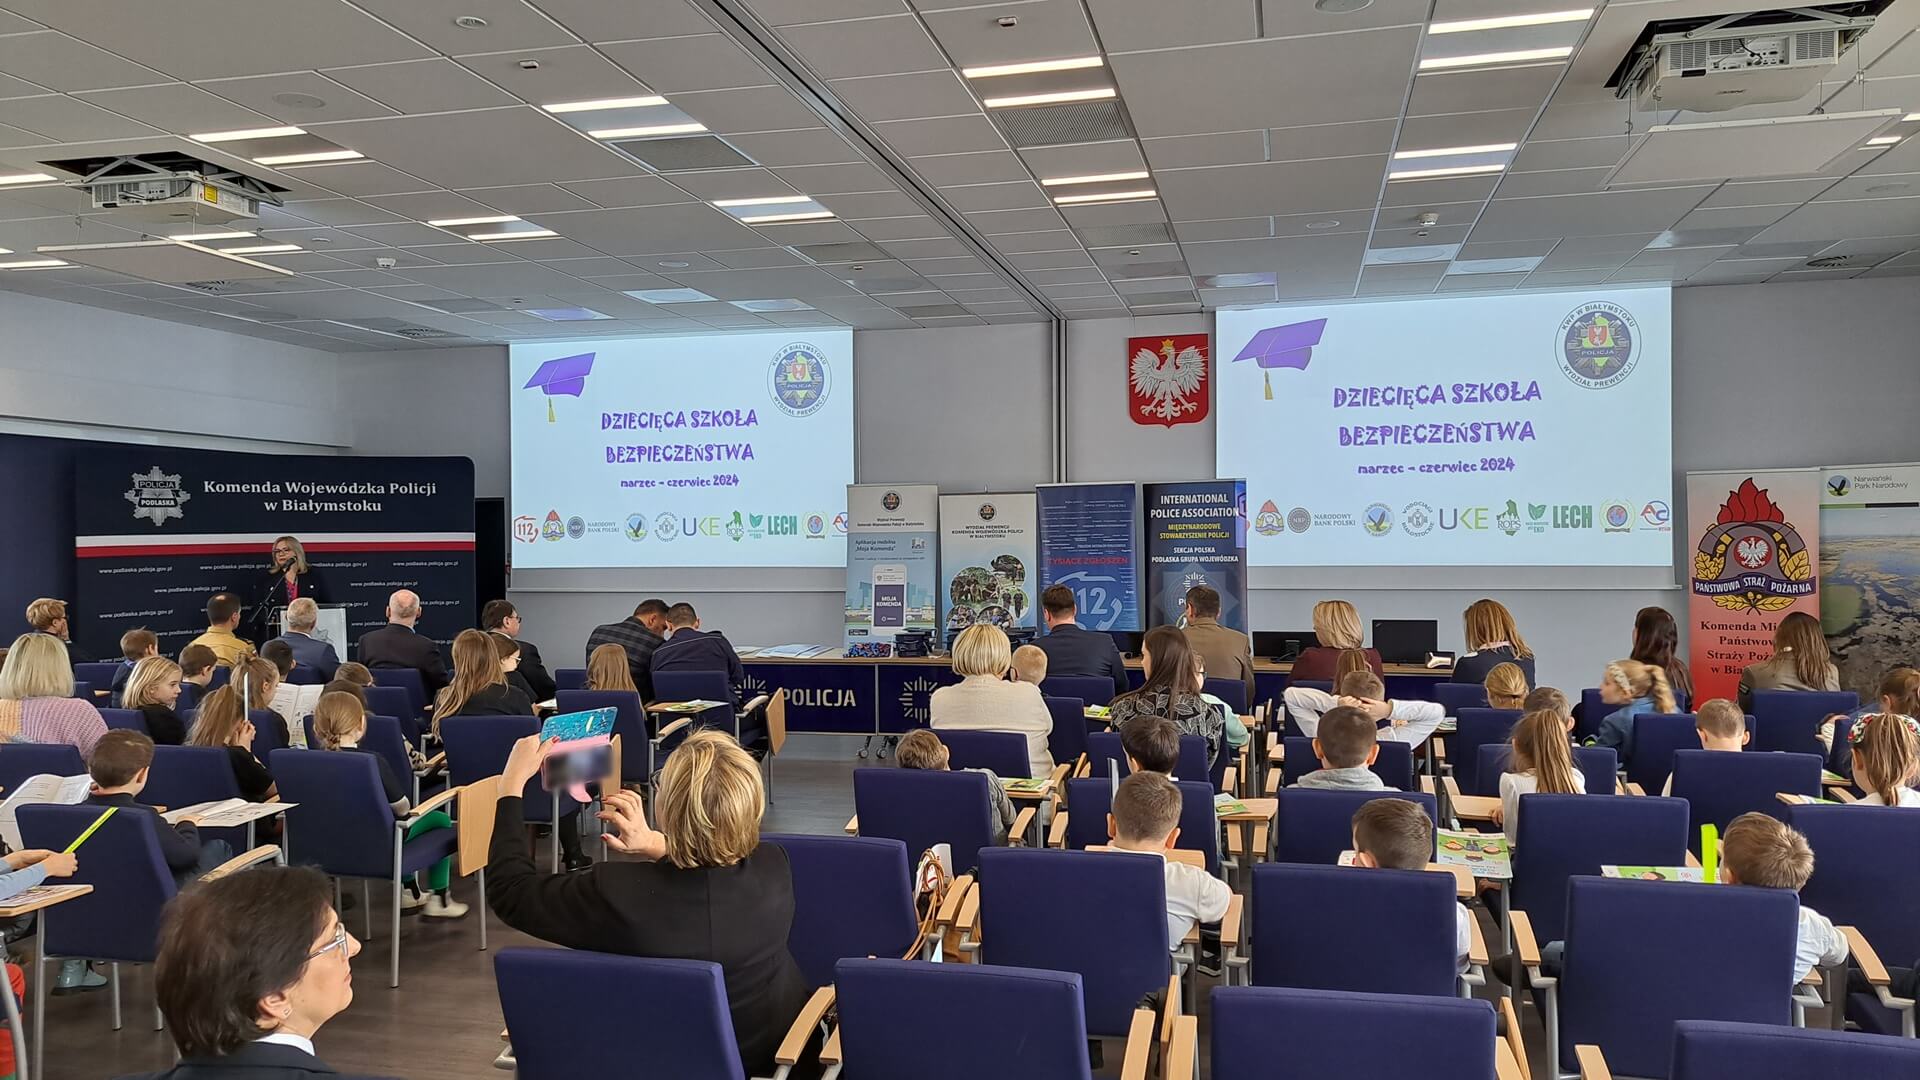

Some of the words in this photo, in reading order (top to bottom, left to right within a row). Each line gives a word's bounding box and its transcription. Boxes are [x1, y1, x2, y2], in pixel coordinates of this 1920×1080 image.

[1562, 314, 1575, 330] KWP
[1585, 304, 1635, 328] BIAŁYMSTOKU
[1563, 364, 1591, 387] WYDZIAŁ
[1594, 361, 1633, 387] PREWENCJI
[1333, 385, 1446, 410] DZIECIĘCA
[1451, 380, 1542, 405] SZKOŁA
[601, 411, 687, 432] DZIECIĘCA
[691, 409, 758, 428] SZKOŁA
[1338, 420, 1537, 446] BEZPIECZEŃSTWA
[605, 443, 754, 463] BEZPIECZEŃSTWA
[1358, 463, 1404, 474] marzec
[1419, 460, 1477, 473] czerwiec
[1480, 457, 1515, 473] 2024
[204, 481, 281, 493] Komenda
[285, 482, 385, 496] Wojewódzka
[390, 482, 437, 496] Policji
[620, 478, 656, 488] marzec
[667, 477, 711, 487] czerwiec
[712, 474, 739, 487] 2024
[264, 502, 278, 511] w
[282, 499, 382, 514] Białymstoku
[1161, 494, 1229, 504] INTERNATIONAL
[1151, 508, 1180, 518] POLICE
[1182, 507, 1239, 518] ASSOCIATION
[1439, 508, 1489, 530] UKE
[1553, 505, 1592, 529] LECH
[517, 523, 533, 536] 112
[682, 517, 721, 536] UKE
[767, 515, 798, 535] LECH
[1168, 523, 1221, 531] MIĘDZYNARODOWE
[1497, 519, 1521, 529] ROPS
[1199, 554, 1239, 562] WOJEWÓDZKA
[99, 566, 172, 574] www.podlaska.policja.gov.pl
[1695, 580, 1741, 593] PAŃSTWOWA
[1743, 576, 1766, 587] STRAŻ
[1771, 582, 1812, 593] POŻARNA
[1072, 587, 1107, 615] 12
[1701, 621, 1757, 632] Komenda
[1719, 635, 1774, 646] Państwow
[1707, 650, 1745, 662] Straży
[1711, 666, 1719, 674] w
[783, 688, 857, 706] POLICJA
